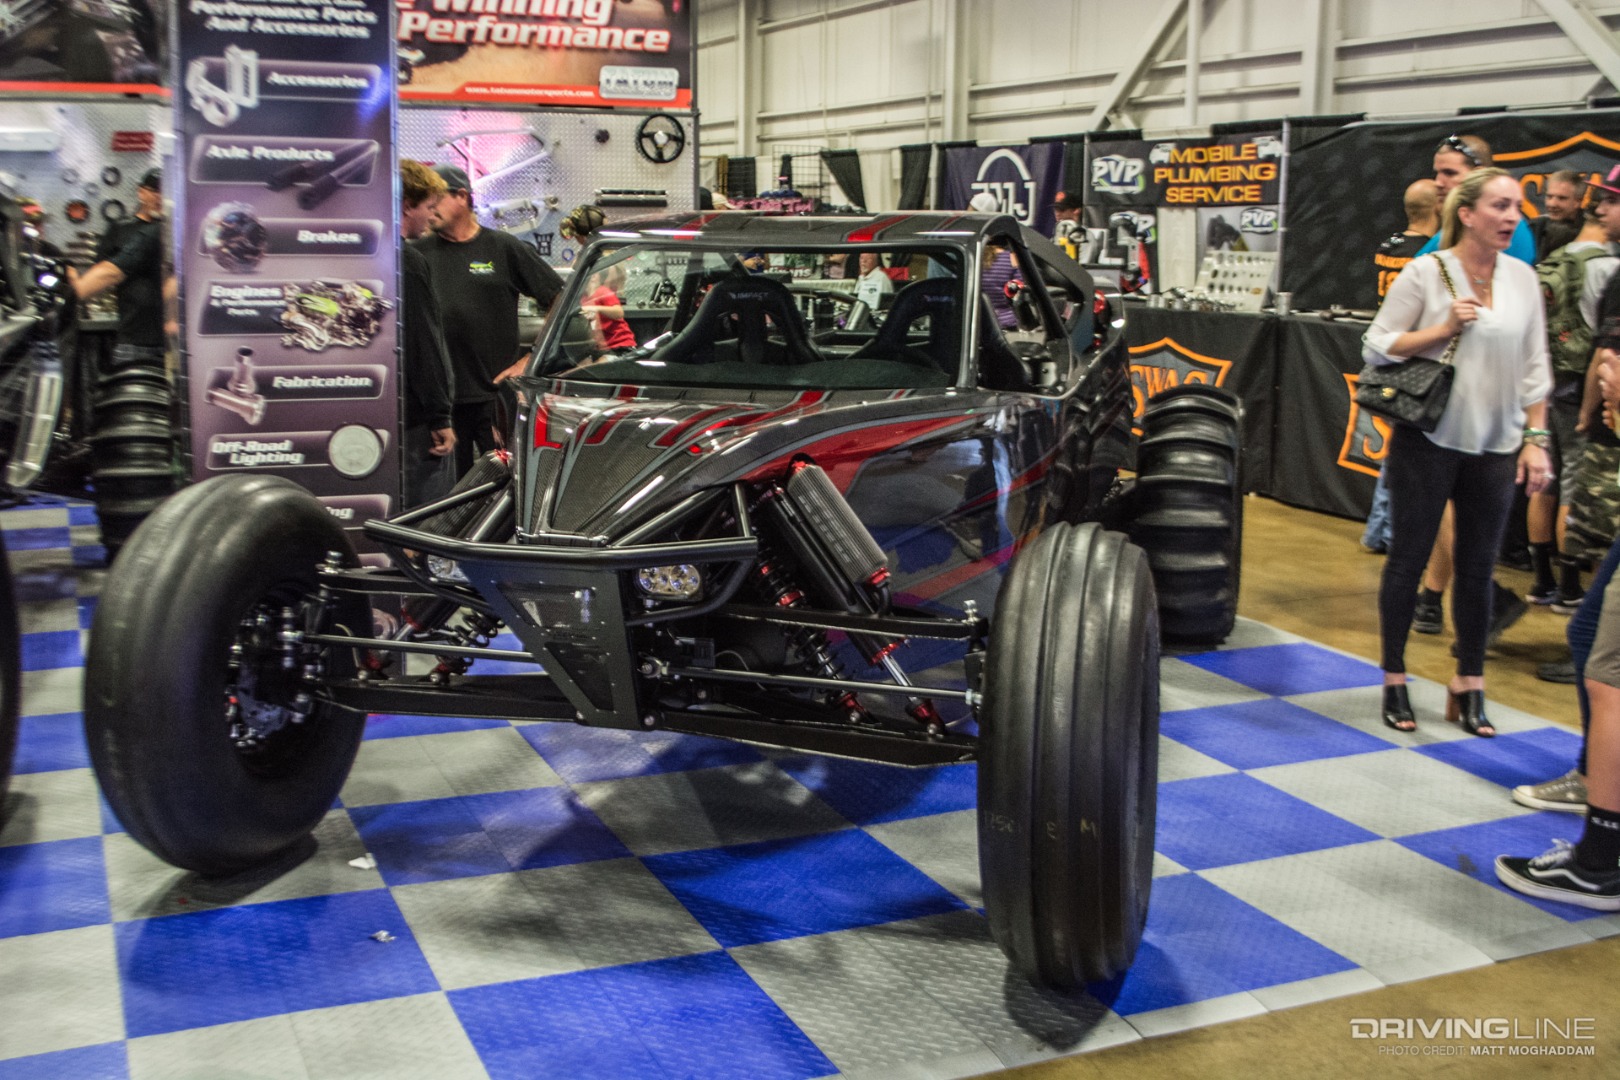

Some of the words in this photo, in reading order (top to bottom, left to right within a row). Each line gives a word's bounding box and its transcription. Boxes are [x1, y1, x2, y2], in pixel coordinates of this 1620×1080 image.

[322, 6, 378, 24] Parts
[206, 15, 249, 32] And
[251, 17, 371, 39] Accessories
[398, 11, 671, 51] Performance
[267, 71, 369, 88] Accessories
[207, 144, 250, 160] Axle
[252, 146, 335, 163] Products
[1170, 143, 1257, 164] MOBILE
[1092, 157, 1144, 187] PVP
[1154, 163, 1277, 184] PLUMBING
[1165, 184, 1262, 203] SERVICE
[1241, 209, 1277, 227] PVP
[297, 229, 361, 244] Brakes
[210, 285, 282, 299] Engines
[273, 375, 373, 389] Fabrication
[229, 450, 305, 466] Lighting
